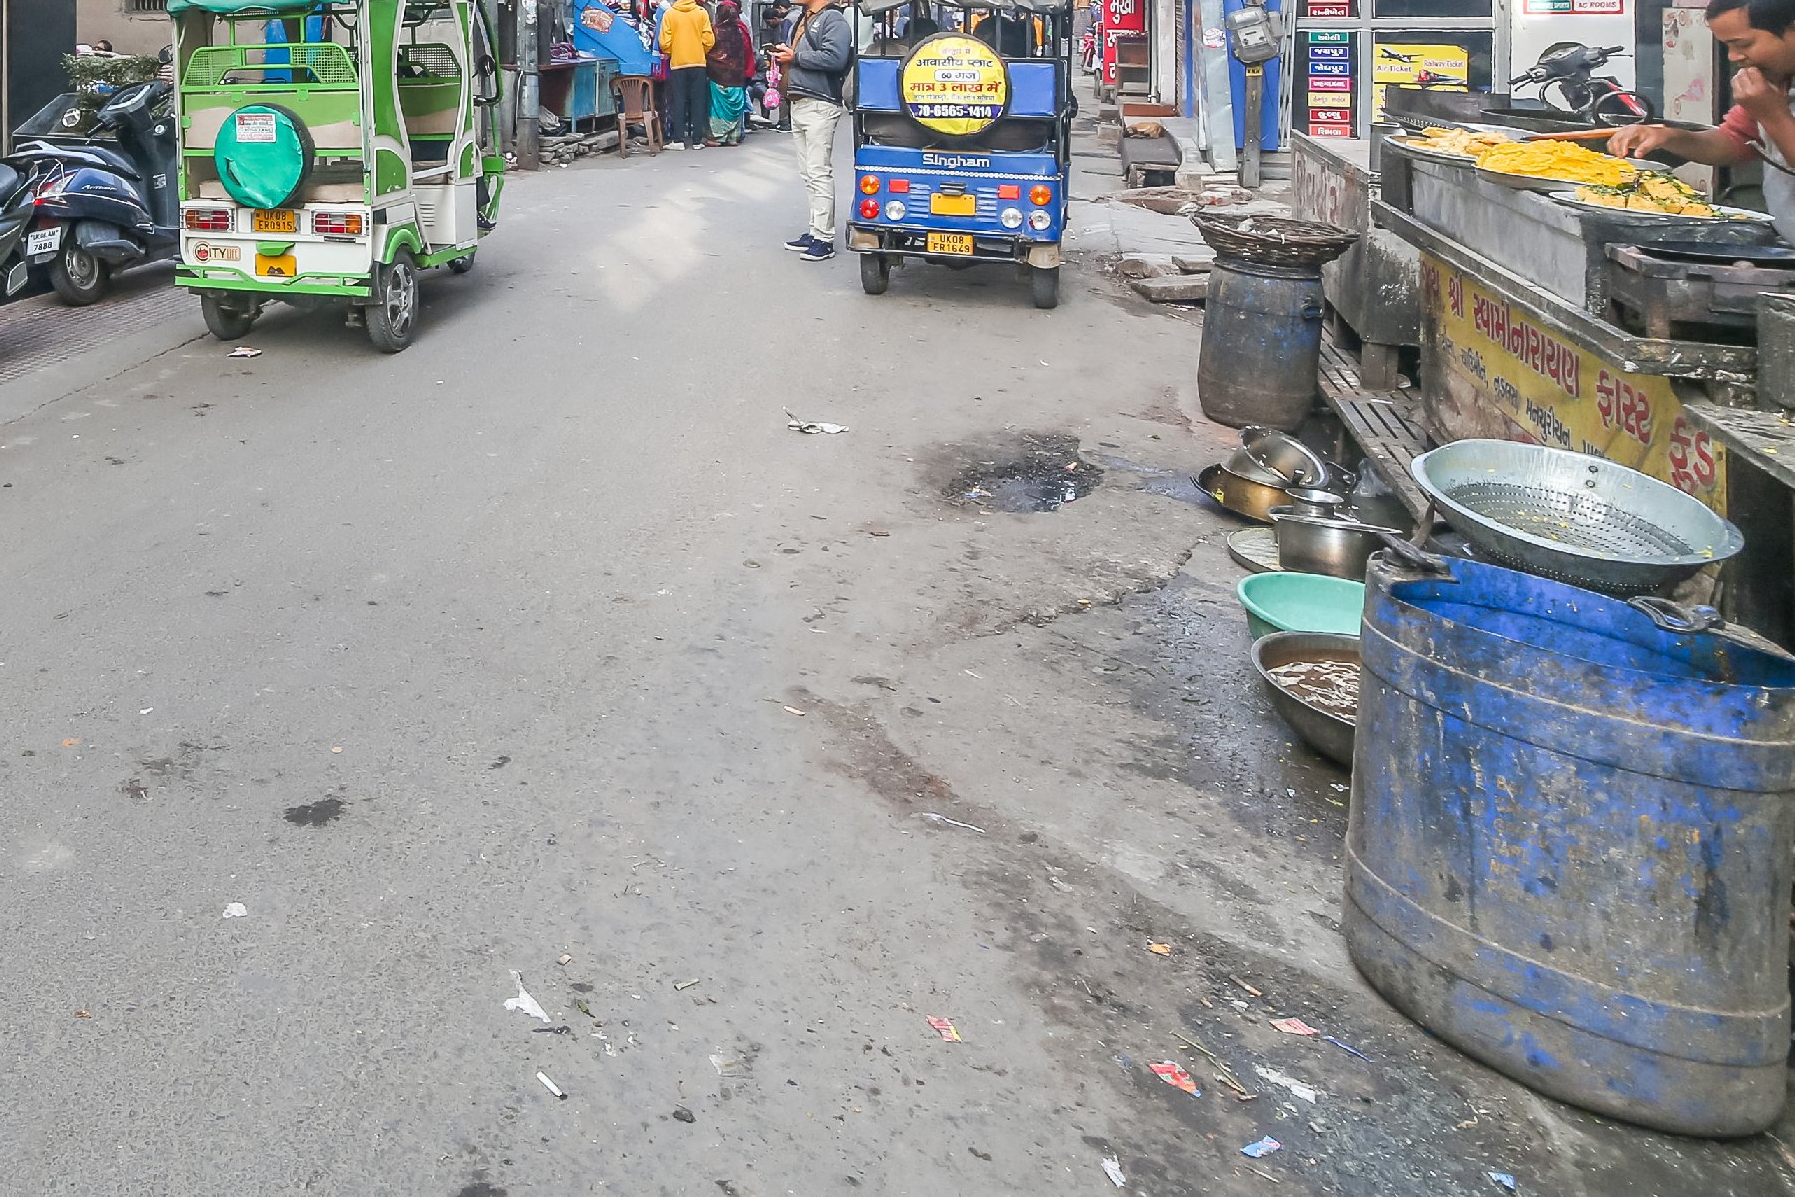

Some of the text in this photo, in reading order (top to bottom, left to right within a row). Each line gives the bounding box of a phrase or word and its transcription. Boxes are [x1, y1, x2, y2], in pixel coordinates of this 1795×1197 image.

[1389, 65, 1412, 73] Ticket
[939, 83, 947, 92] 3
[951, 83, 984, 93] लाख
[922, 154, 990, 168] Singham
[258, 221, 293, 231] ER0915
[939, 234, 964, 244] UK08
